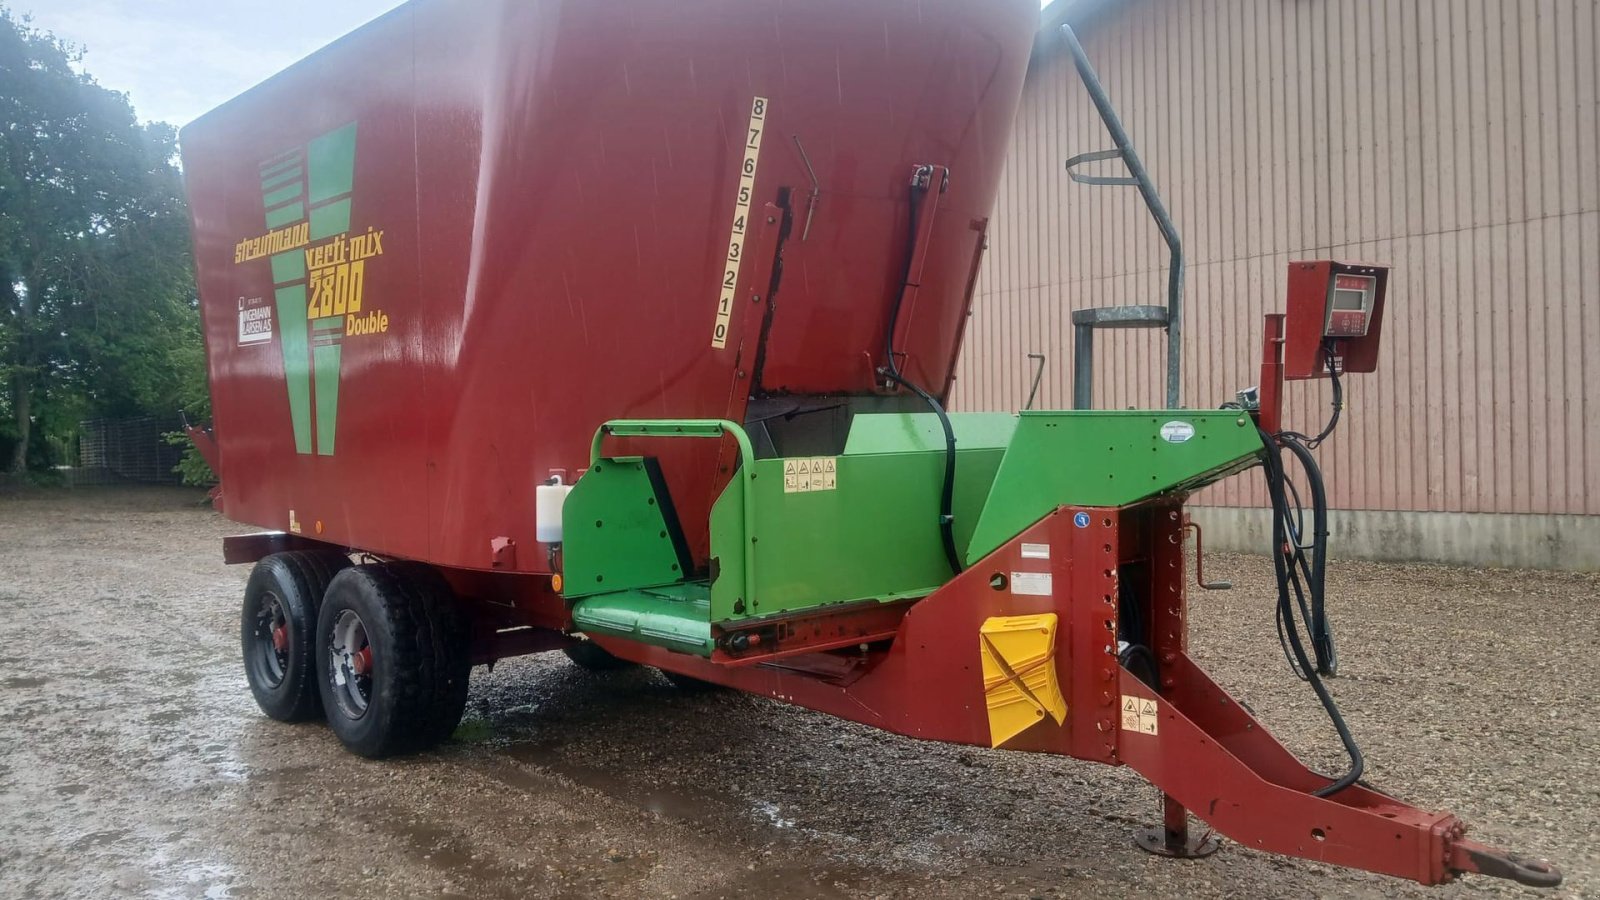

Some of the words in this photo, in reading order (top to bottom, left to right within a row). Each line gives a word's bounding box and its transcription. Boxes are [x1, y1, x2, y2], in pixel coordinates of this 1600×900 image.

[753, 99, 764, 115] 8
[750, 128, 760, 144] 7
[743, 158, 754, 174] 6
[739, 187, 750, 202] 5
[734, 215, 745, 231] 4
[235, 221, 310, 264] strautmann
[305, 226, 384, 270] verti-mix
[729, 243, 740, 258] 3
[724, 270, 736, 285] 2
[307, 260, 365, 320] 2800
[721, 298, 729, 312] 1
[346, 309, 389, 336] Double
[715, 324, 726, 338] 0
